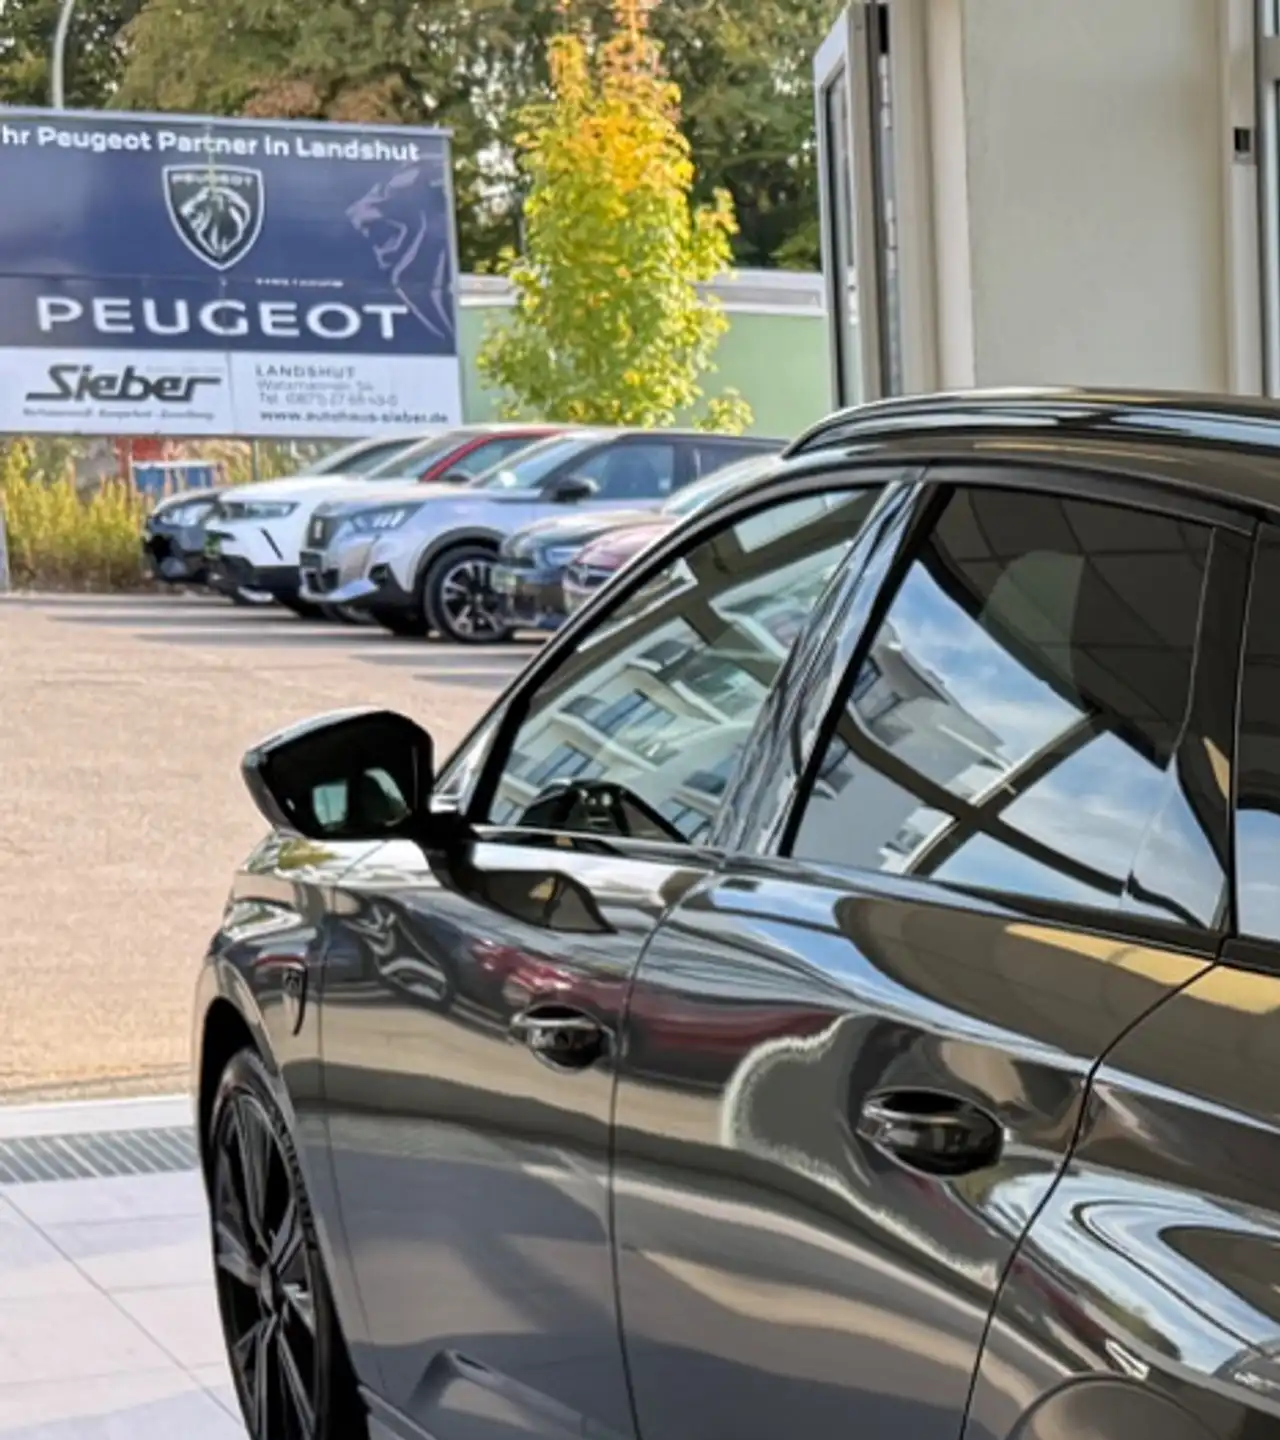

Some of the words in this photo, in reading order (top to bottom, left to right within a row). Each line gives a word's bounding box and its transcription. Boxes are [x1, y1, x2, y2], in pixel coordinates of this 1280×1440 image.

[37, 126, 152, 153] Peugeot
[157, 130, 258, 156] Partner
[264, 135, 290, 157] in
[296, 137, 420, 162] Landshut
[37, 296, 408, 341] PEUGEOT
[25, 364, 222, 403] Sieber
[256, 364, 356, 379] LANDSHUT
